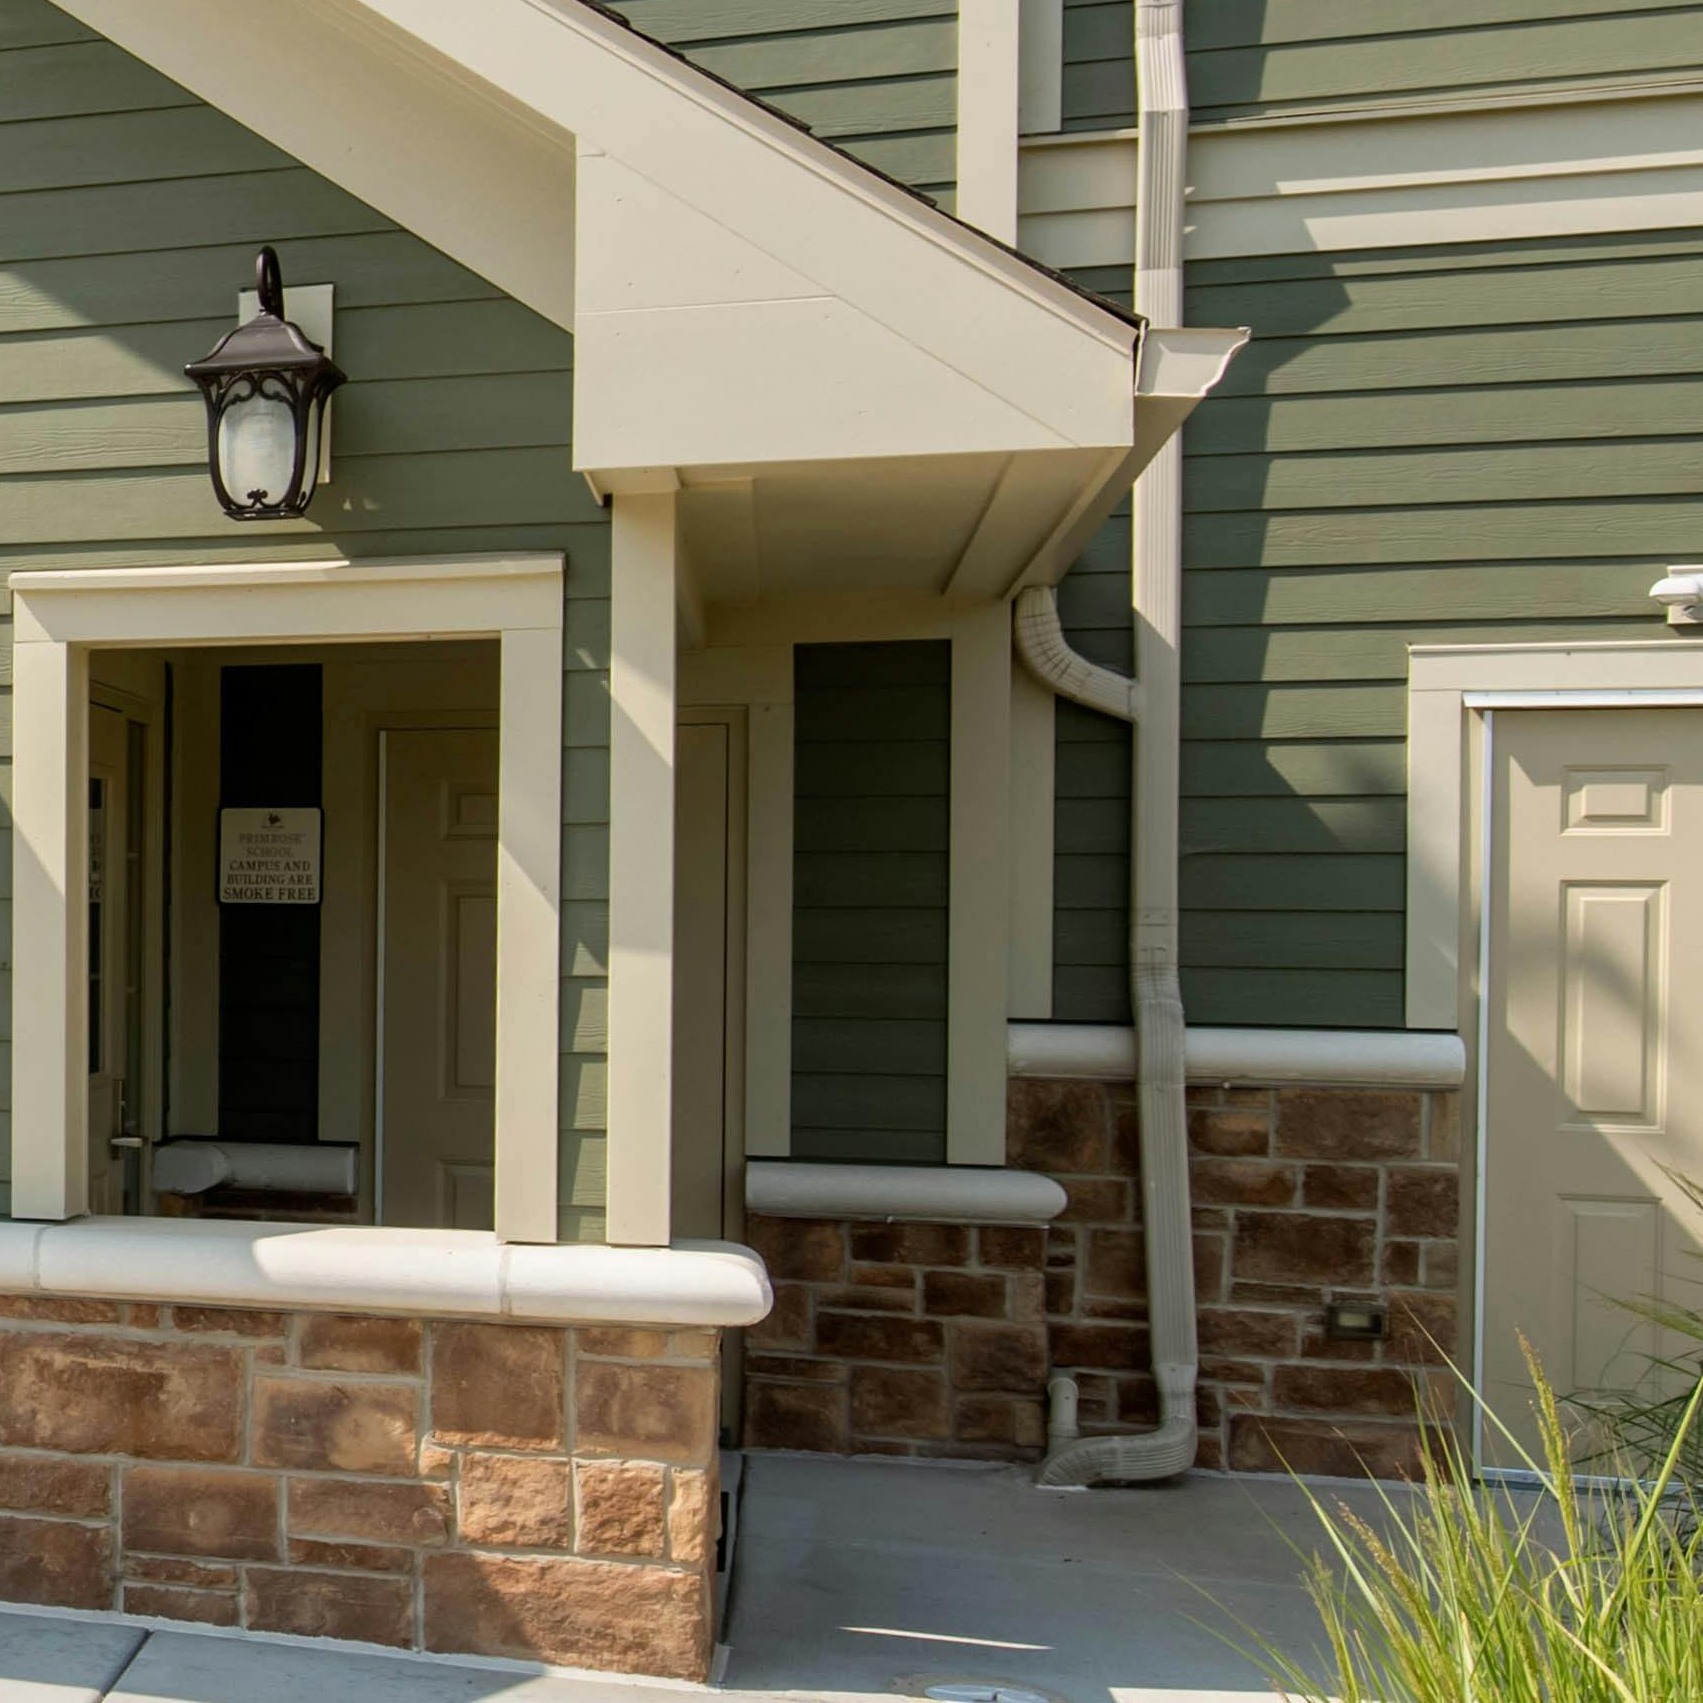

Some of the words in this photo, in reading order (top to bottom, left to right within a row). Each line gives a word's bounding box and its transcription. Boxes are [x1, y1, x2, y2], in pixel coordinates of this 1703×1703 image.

[245, 847, 294, 858] SCHOOL
[229, 860, 281, 872] CAMPUS
[283, 860, 311, 872] AND
[226, 874, 285, 885] BUILDING
[287, 874, 313, 885] ARE
[223, 887, 275, 899] SMOKE
[278, 888, 316, 900] FREE
